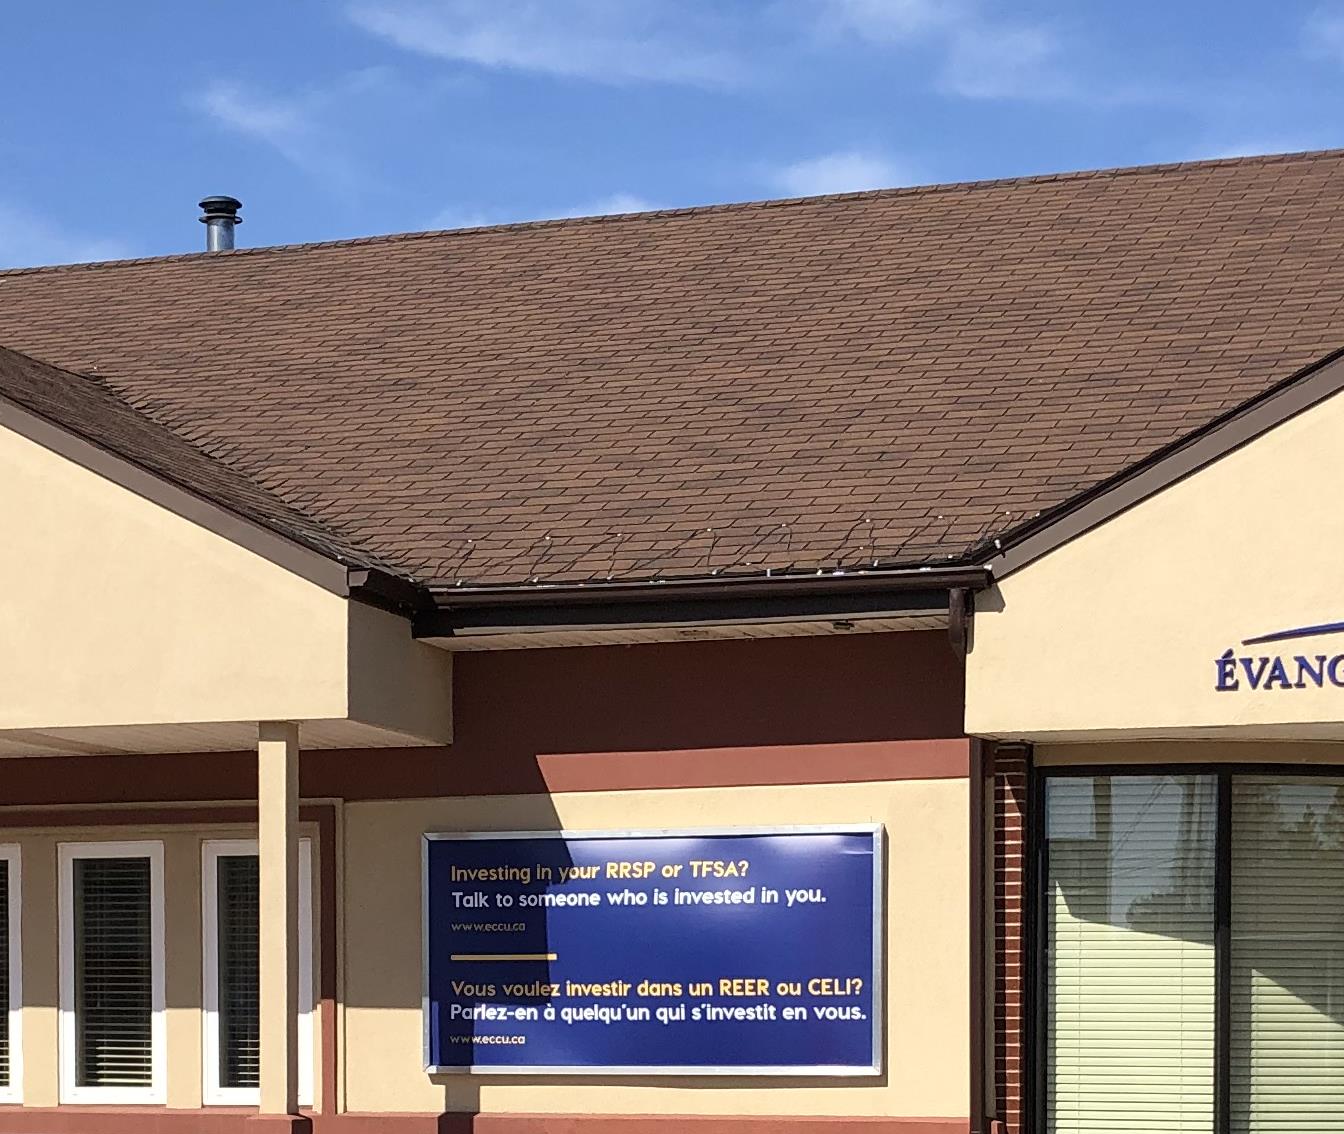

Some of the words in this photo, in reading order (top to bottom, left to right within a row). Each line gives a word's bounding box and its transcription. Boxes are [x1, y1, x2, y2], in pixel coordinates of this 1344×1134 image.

[451, 865, 531, 884] Investing
[536, 864, 552, 881] in
[559, 865, 600, 884] your
[606, 861, 656, 879] RRSP
[661, 864, 683, 878] or
[689, 860, 749, 878] TFSA?
[452, 891, 490, 908] Talk
[496, 893, 513, 907] to
[519, 892, 601, 907] someone
[606, 888, 648, 906] who
[653, 888, 668, 905] is
[674, 887, 755, 905] invested
[761, 886, 779, 904] in
[785, 888, 826, 907] you.
[451, 921, 526, 932] www.eccu.ca
[451, 980, 496, 997] Vous
[502, 980, 560, 997] voulez
[566, 980, 632, 996] investir
[636, 980, 682, 996] dans
[688, 982, 714, 996] un
[719, 979, 770, 996] REER
[776, 982, 801, 996] ou
[807, 978, 863, 995] CELI?
[450, 1004, 538, 1020] Parlez-en
[543, 1003, 555, 1020] à
[560, 1004, 650, 1024] quelqu'un
[656, 1004, 685, 1024] qui
[691, 1003, 776, 1020] s'investit
[782, 1006, 807, 1020] en
[813, 1006, 867, 1020] vous.
[449, 1034, 526, 1044] www.eccu.ca
